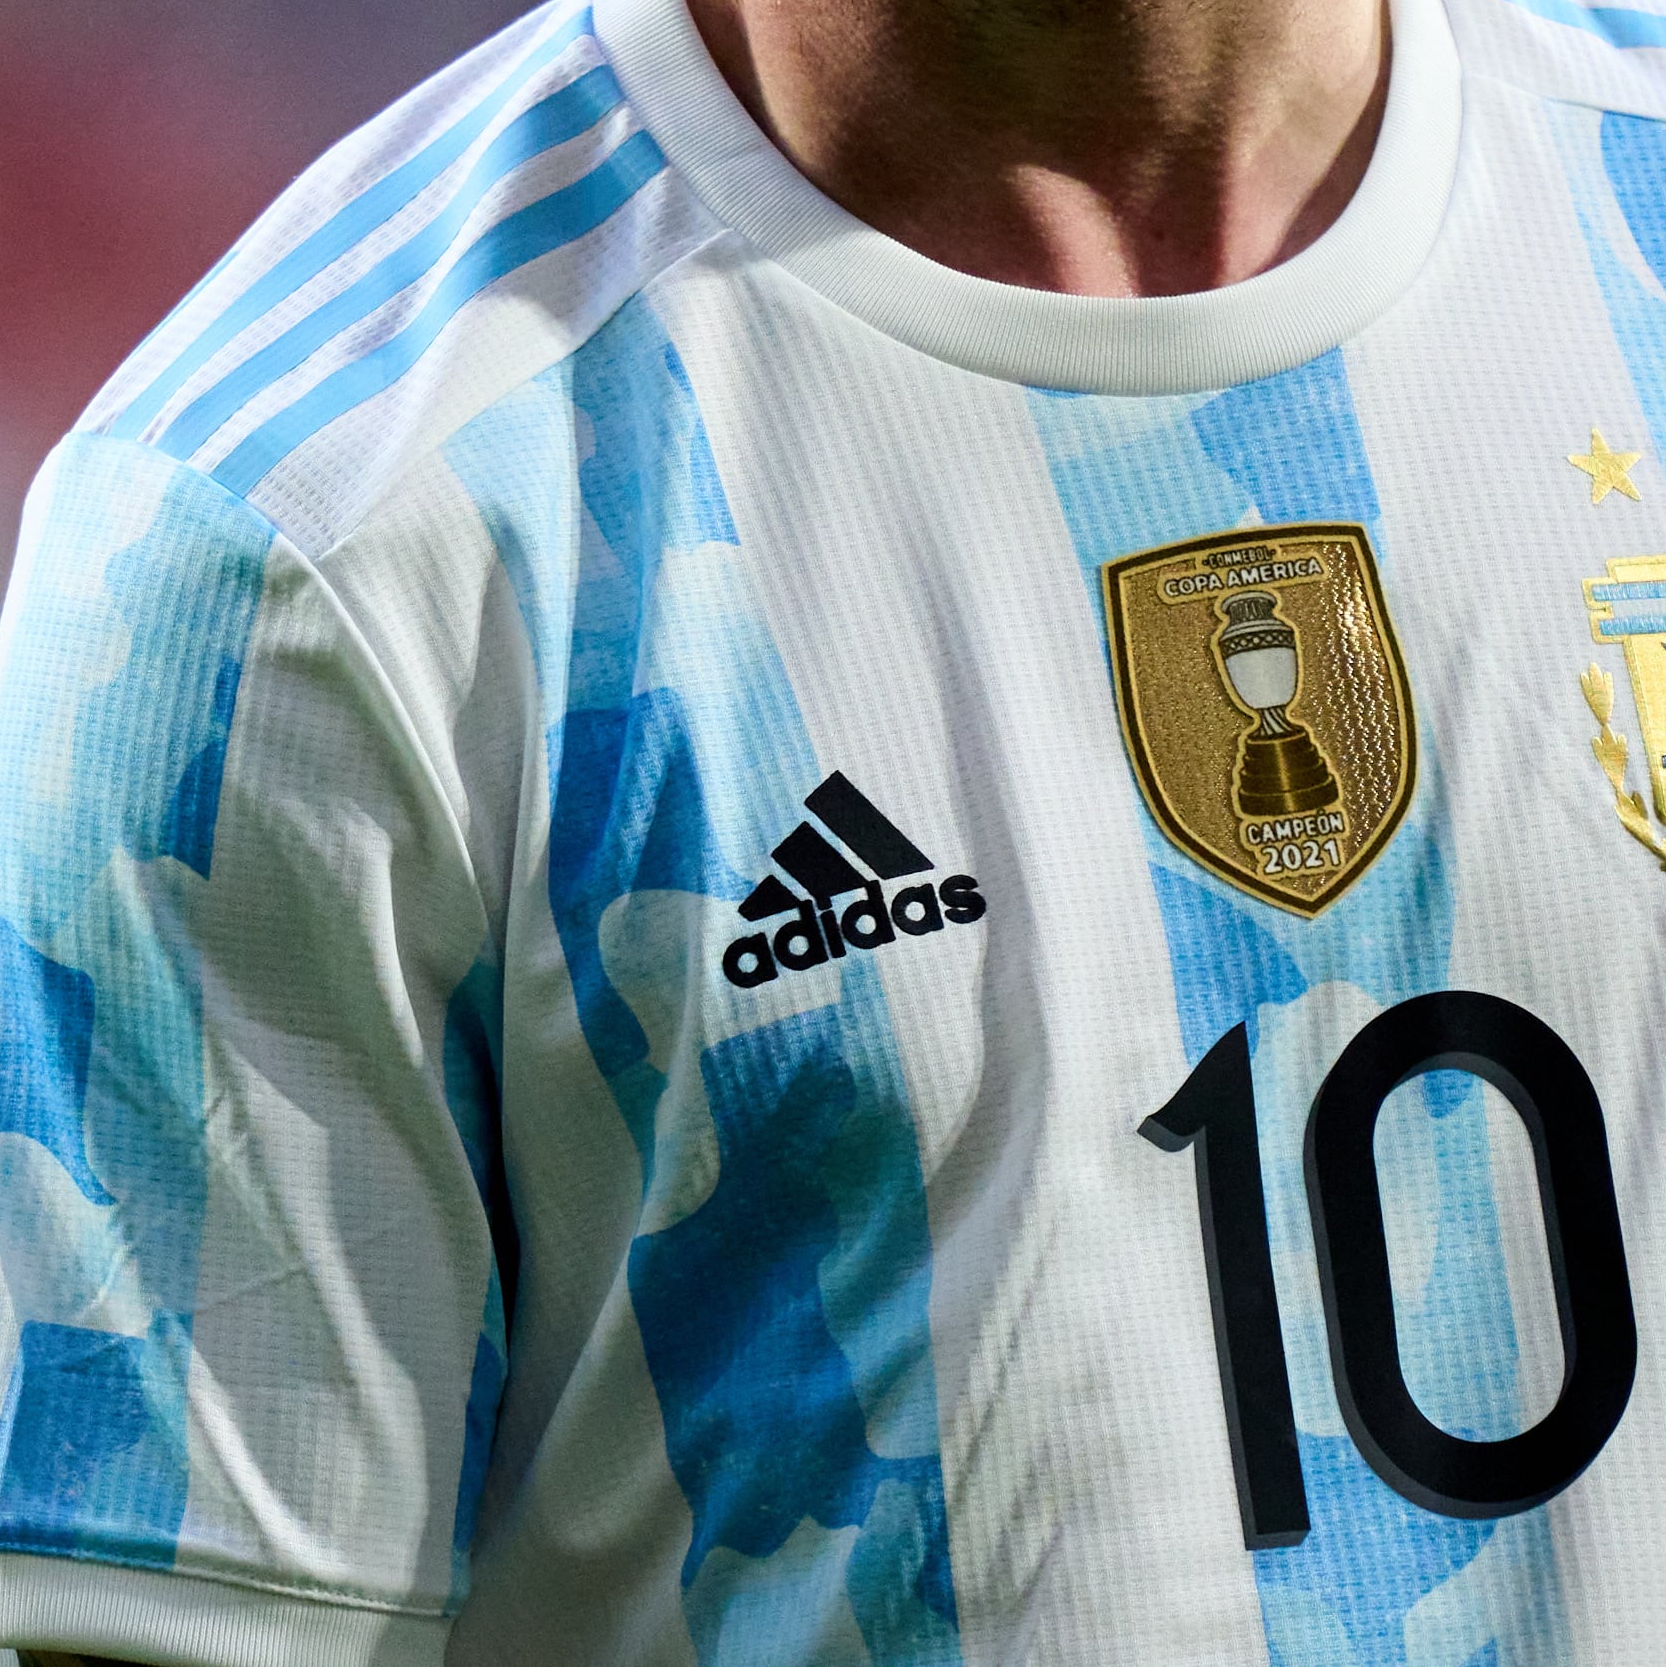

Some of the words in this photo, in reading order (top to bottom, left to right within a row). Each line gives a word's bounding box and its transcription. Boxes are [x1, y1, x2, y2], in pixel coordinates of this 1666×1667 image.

[1208, 545, 1271, 568] CONMEBOL
[1164, 574, 1223, 597] COPA
[1226, 557, 1323, 589] AMERICA
[1261, 838, 1341, 874] 2021
[722, 874, 986, 988] adidas
[1137, 990, 1637, 1551] 10
